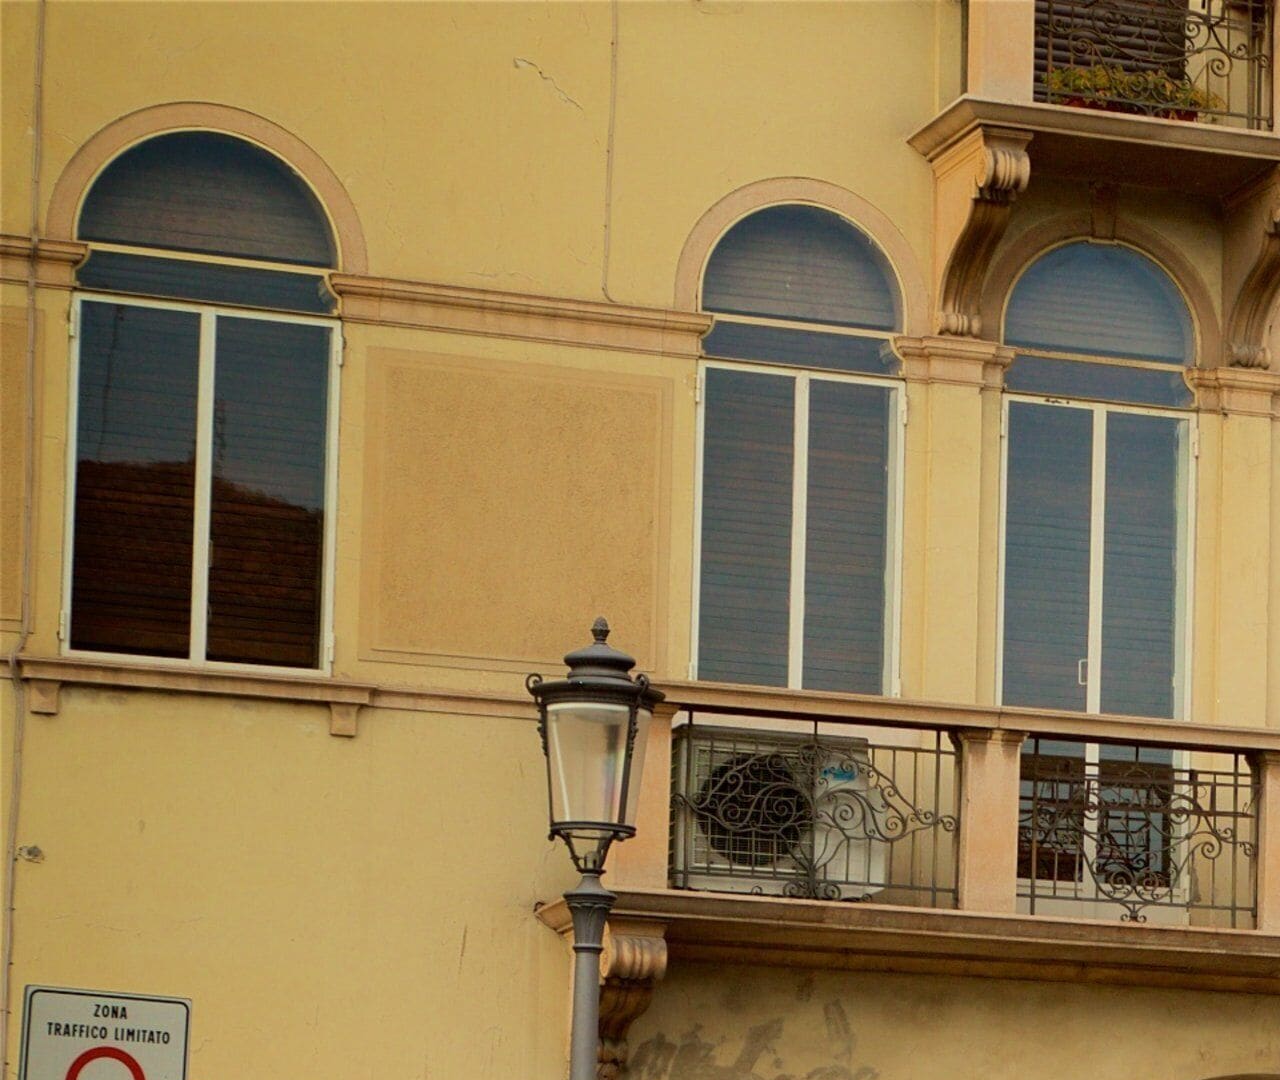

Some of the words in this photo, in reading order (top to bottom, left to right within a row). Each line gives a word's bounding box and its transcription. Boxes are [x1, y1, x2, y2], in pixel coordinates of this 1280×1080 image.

[93, 1003, 128, 1020] ZONA
[47, 1021, 108, 1040] TRAFFICO
[114, 1027, 171, 1045] LIMITATO
